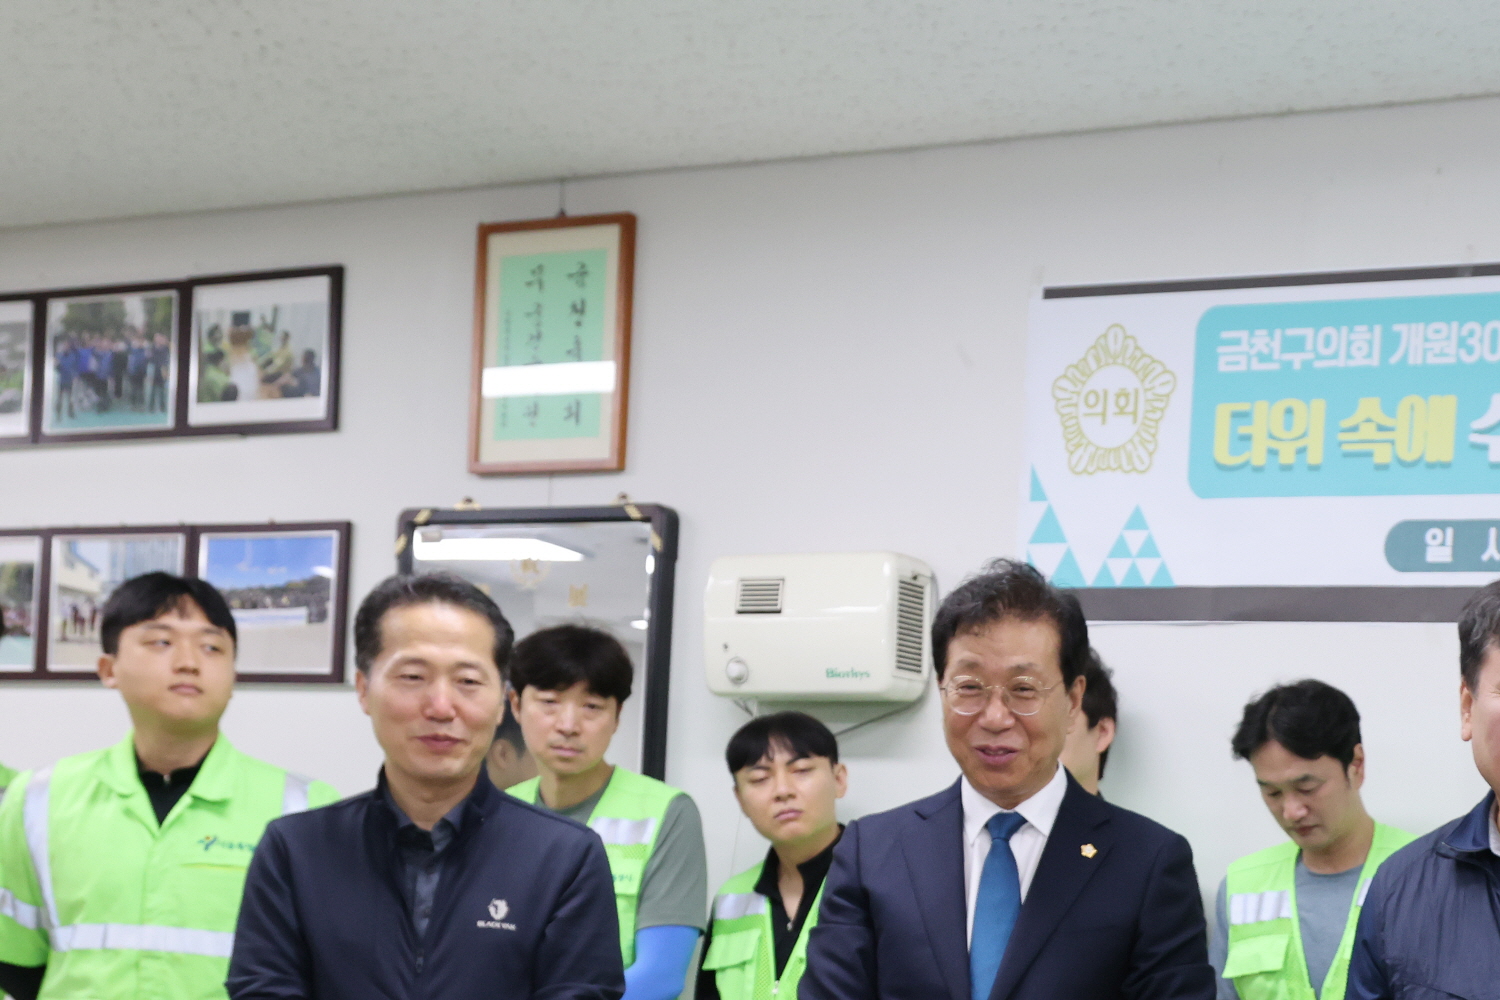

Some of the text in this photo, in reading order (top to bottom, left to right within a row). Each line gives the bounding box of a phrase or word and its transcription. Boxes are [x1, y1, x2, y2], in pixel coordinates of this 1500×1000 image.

[1217, 324, 1381, 372] 금천구의회
[1084, 387, 1139, 425] 의회
[1214, 398, 1326, 466] 더위
[1338, 394, 1458, 464] 속에
[1425, 527, 1454, 563] 일
